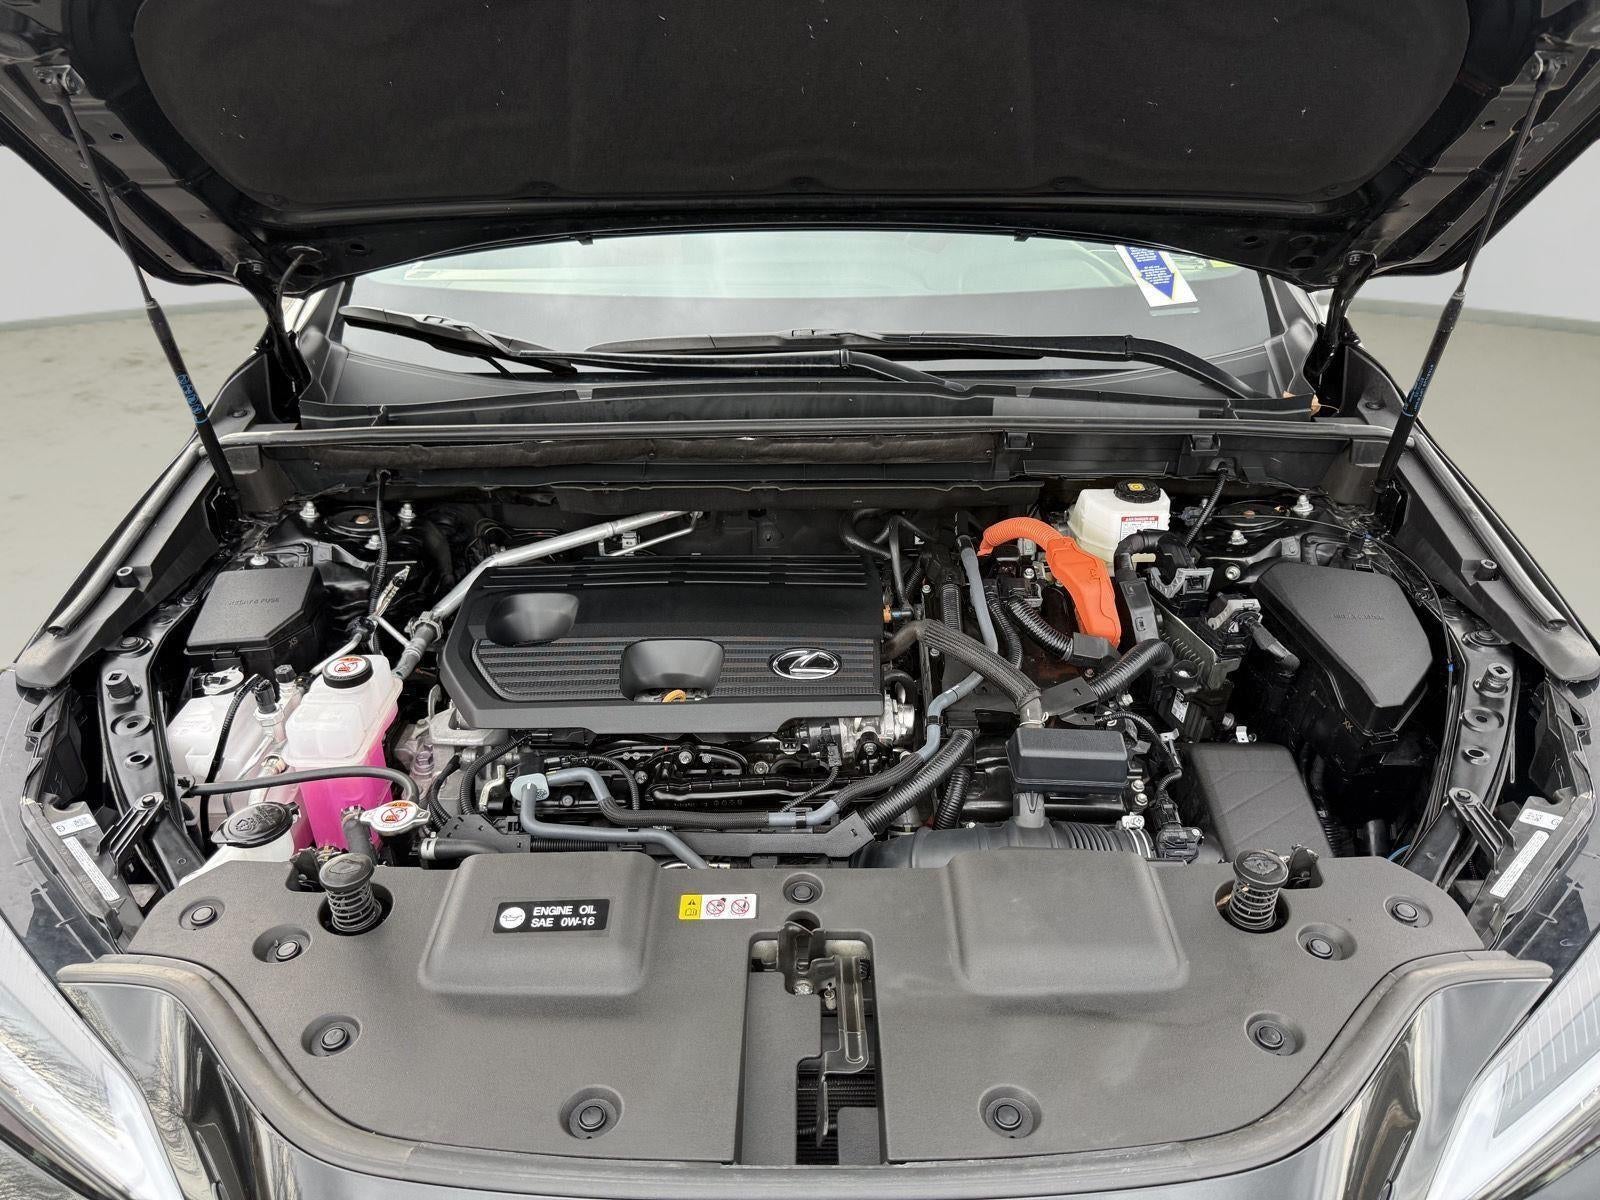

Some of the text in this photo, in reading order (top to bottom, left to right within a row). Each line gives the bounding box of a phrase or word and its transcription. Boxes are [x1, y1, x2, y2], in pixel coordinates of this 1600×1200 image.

[533, 905, 597, 916] ENGINE OIL
[530, 917, 595, 928] SAE 0W-16
